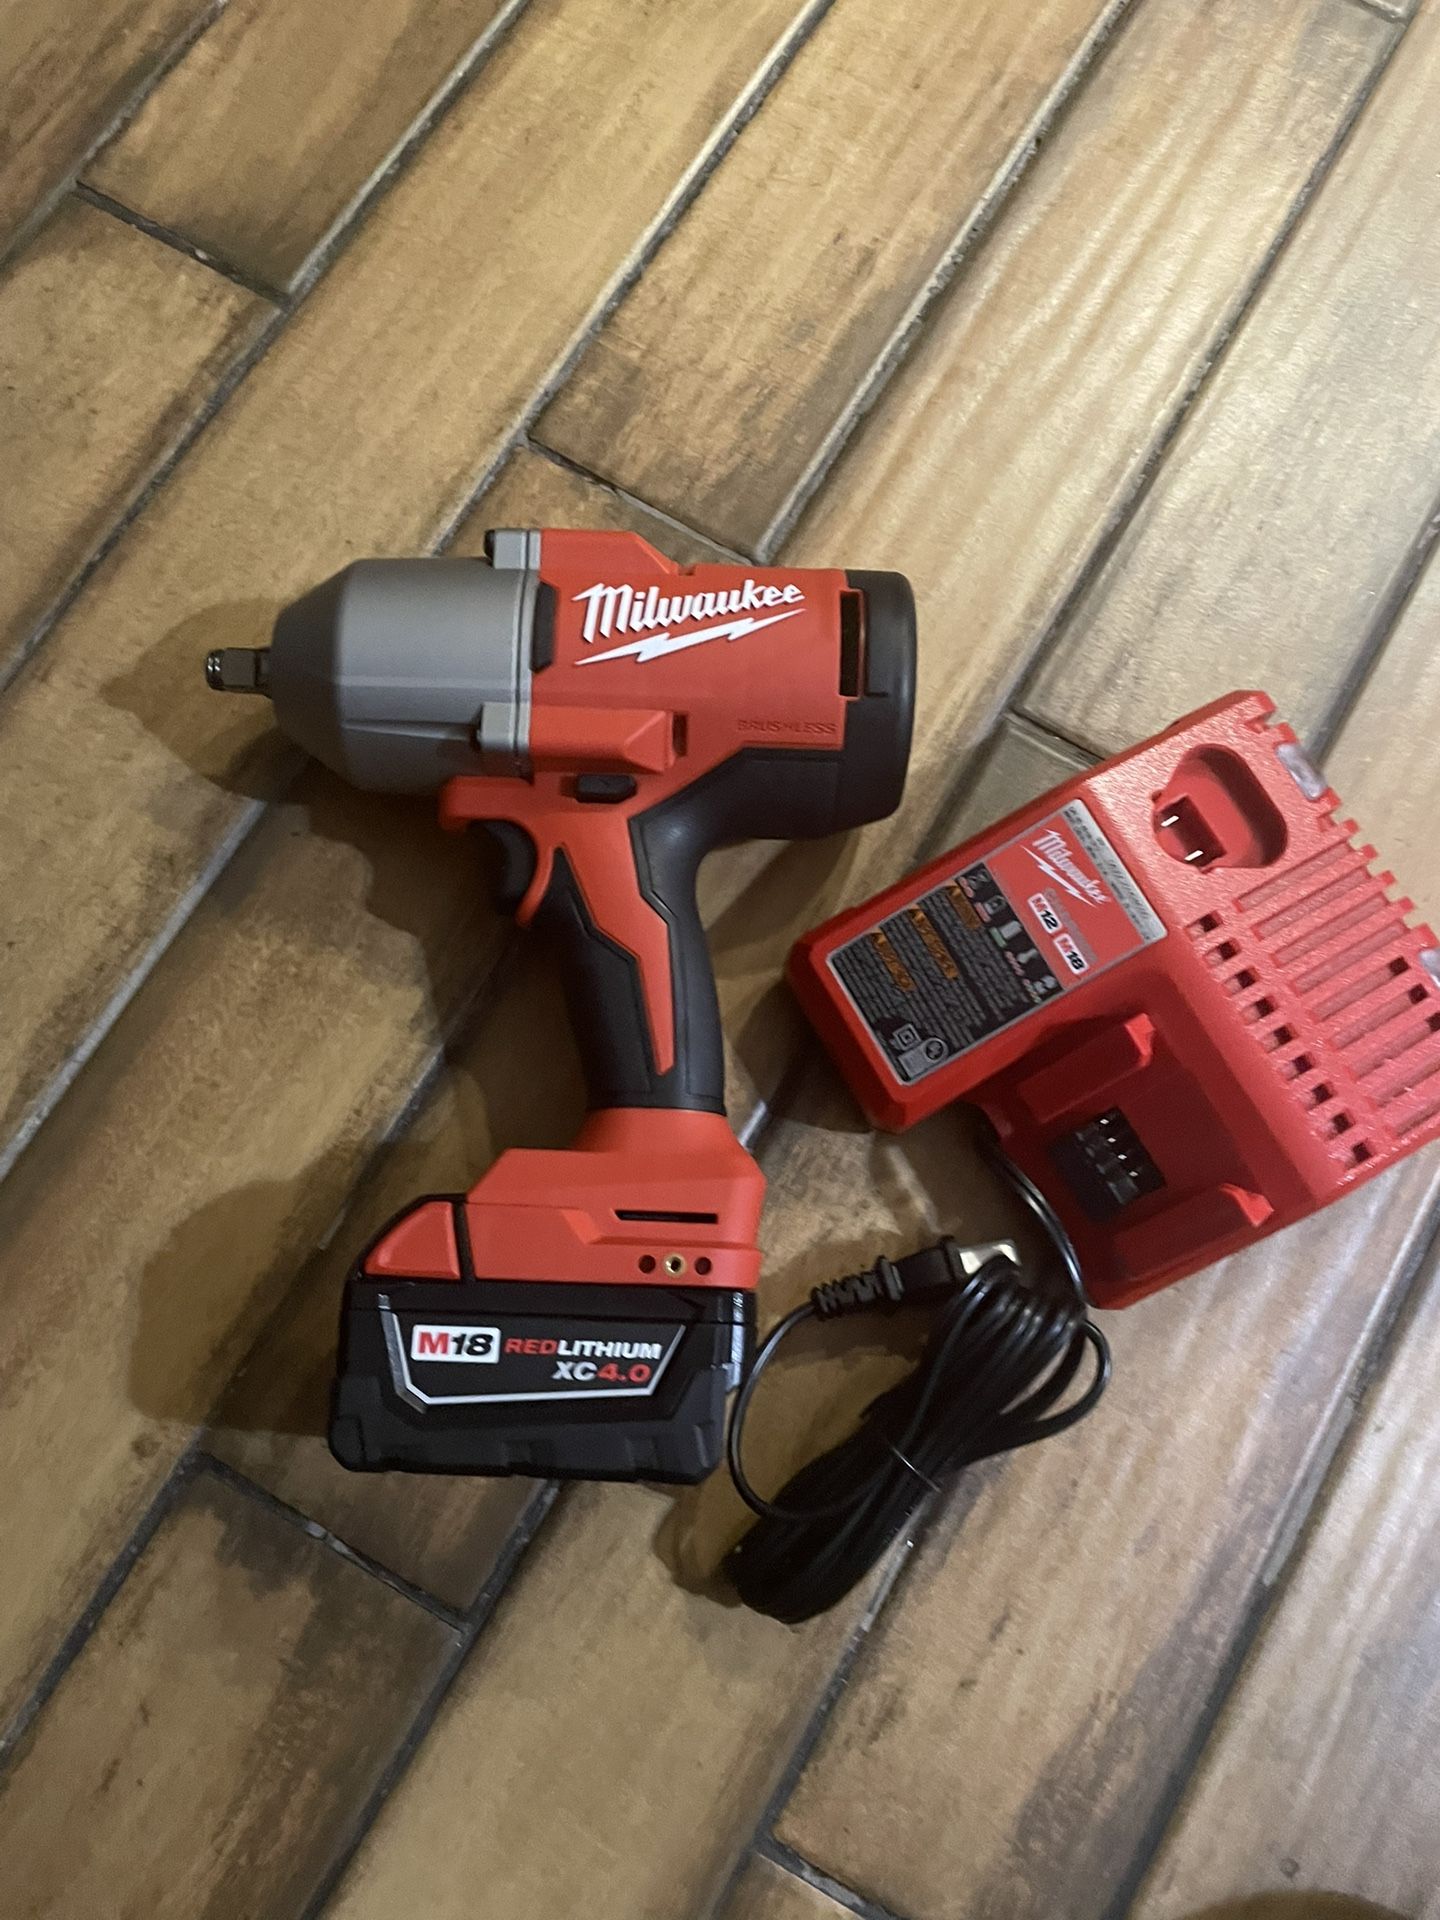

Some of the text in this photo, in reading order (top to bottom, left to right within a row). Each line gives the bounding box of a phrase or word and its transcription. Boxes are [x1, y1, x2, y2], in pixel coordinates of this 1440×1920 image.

[572, 579, 805, 643] Milwaukee
[1032, 896, 1059, 930] M12
[1057, 938, 1085, 971] M18
[417, 1331, 662, 1360] M18 REDLITHIUM
[552, 1361, 651, 1383] XC4.0
